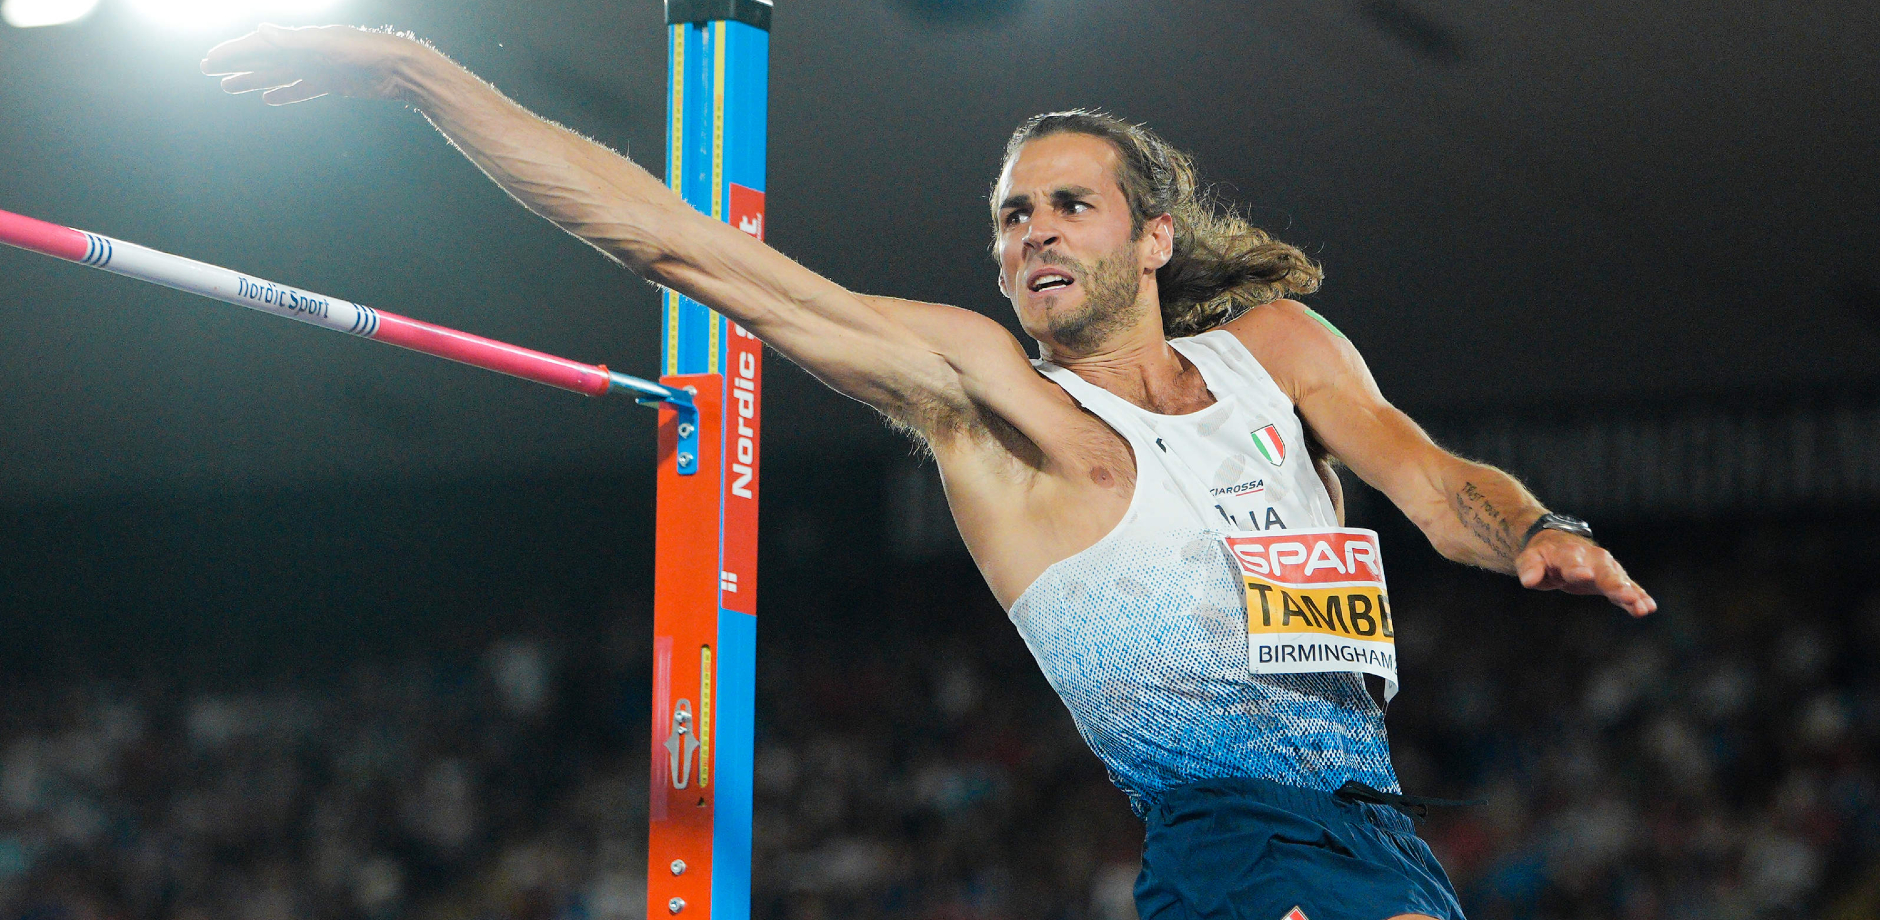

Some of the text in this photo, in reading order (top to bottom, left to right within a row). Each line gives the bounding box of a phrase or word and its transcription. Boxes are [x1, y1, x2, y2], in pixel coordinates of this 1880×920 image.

[288, 290, 330, 319] Sport
[732, 351, 756, 499] Nordic
[1233, 540, 1380, 576] SPAR
[1259, 644, 1393, 670] BIRMINGHAM
